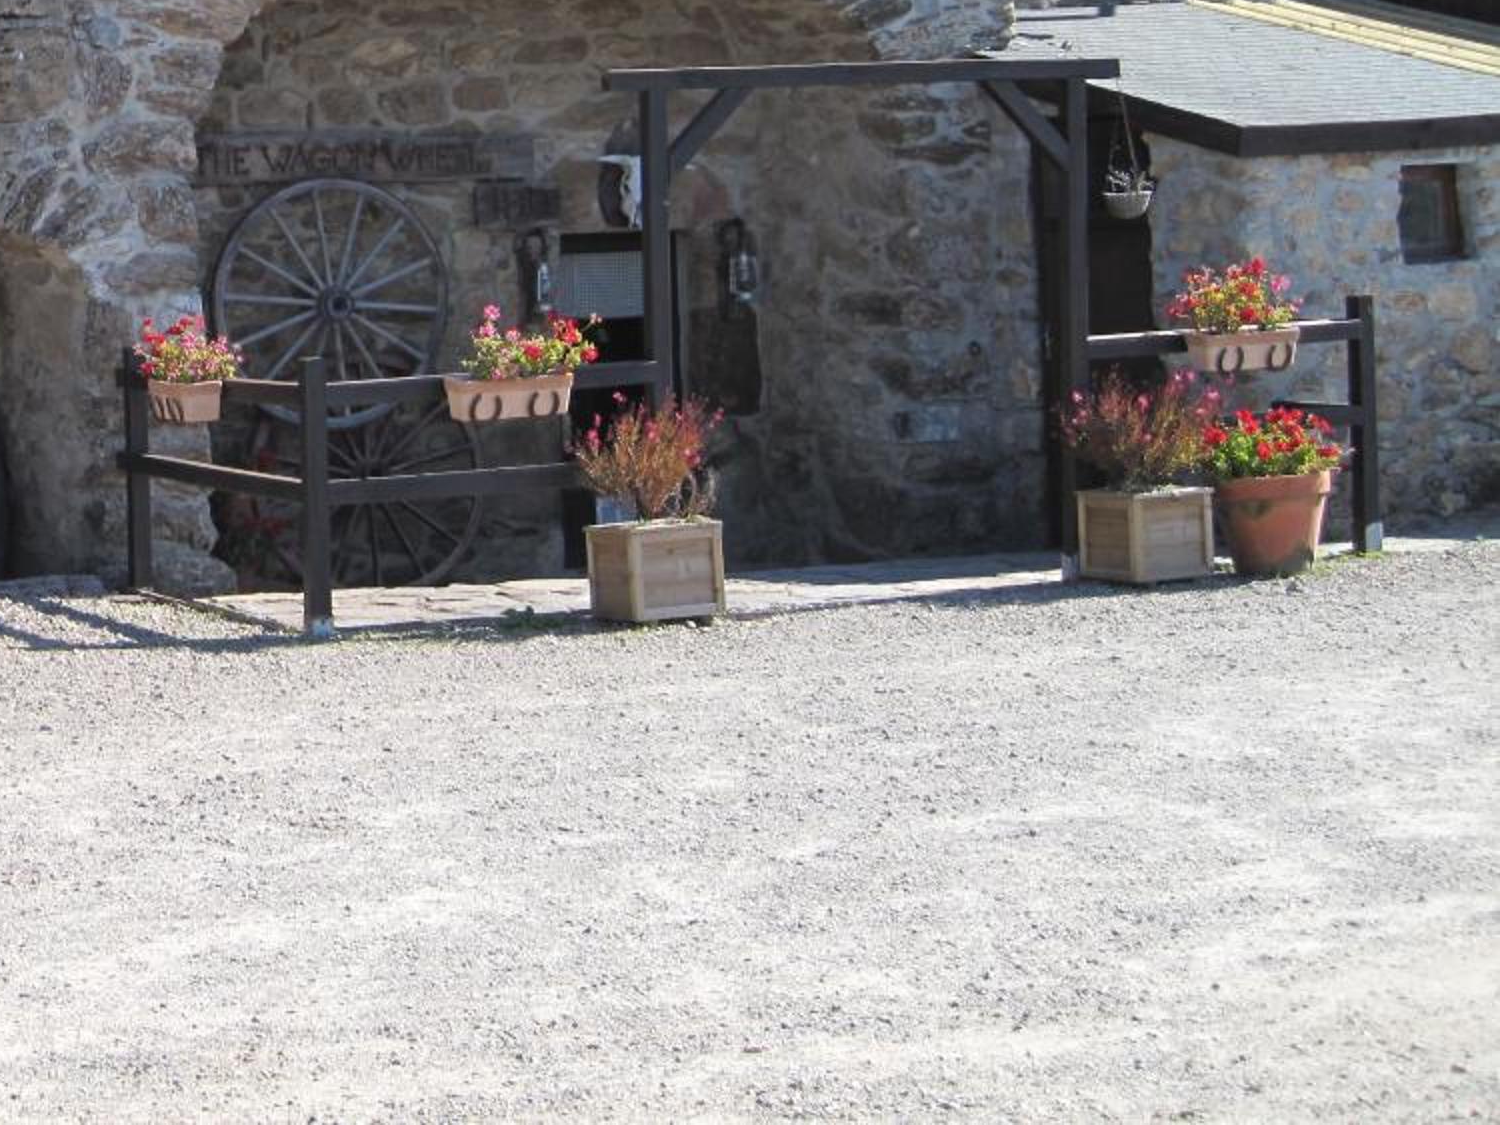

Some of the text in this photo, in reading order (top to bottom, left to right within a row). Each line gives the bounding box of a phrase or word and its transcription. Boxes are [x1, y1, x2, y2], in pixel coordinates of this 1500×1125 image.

[197, 138, 487, 176] THE WAGON WHEEL
